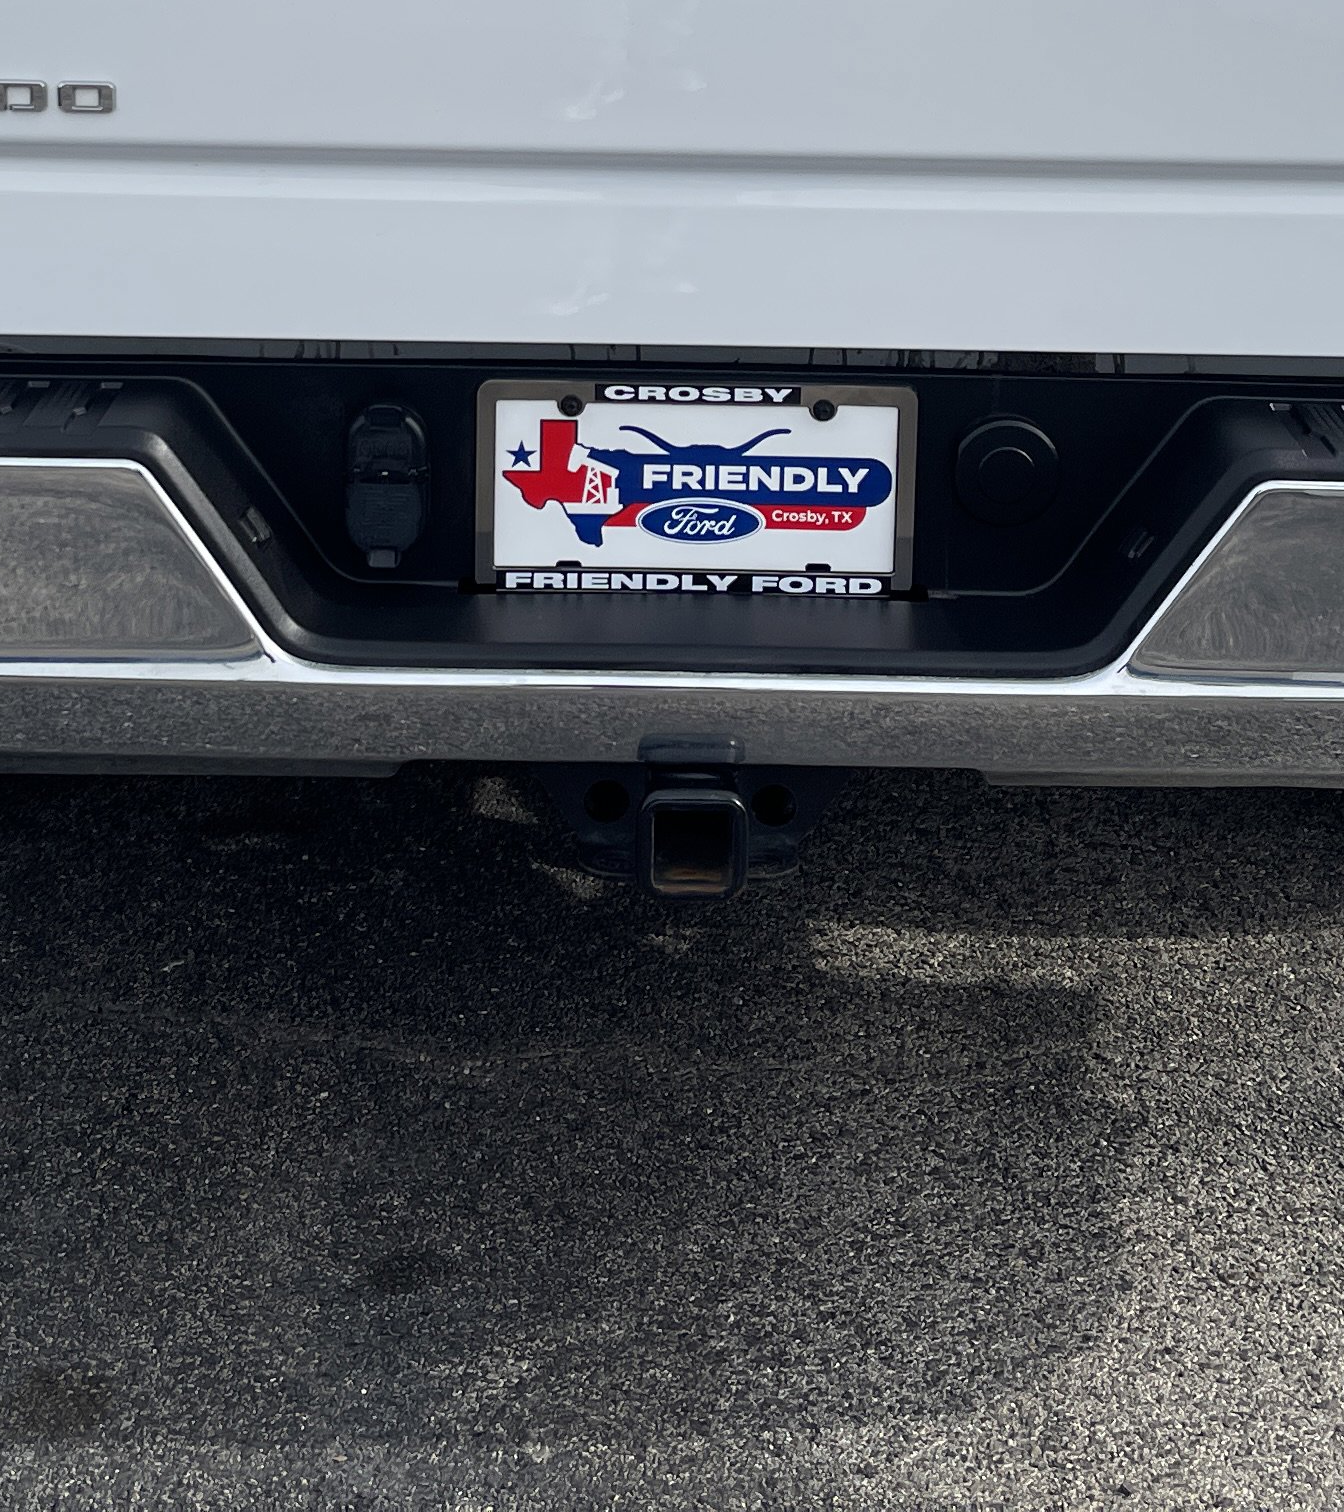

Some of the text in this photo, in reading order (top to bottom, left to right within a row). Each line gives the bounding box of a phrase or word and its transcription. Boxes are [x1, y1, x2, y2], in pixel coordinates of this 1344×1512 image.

[603, 385, 793, 403] CROSBY
[642, 464, 870, 494] FRIENDLY
[662, 505, 738, 538] Ford
[771, 508, 853, 526] Crosby, TX
[505, 571, 883, 595] FRIENDLY FORD
